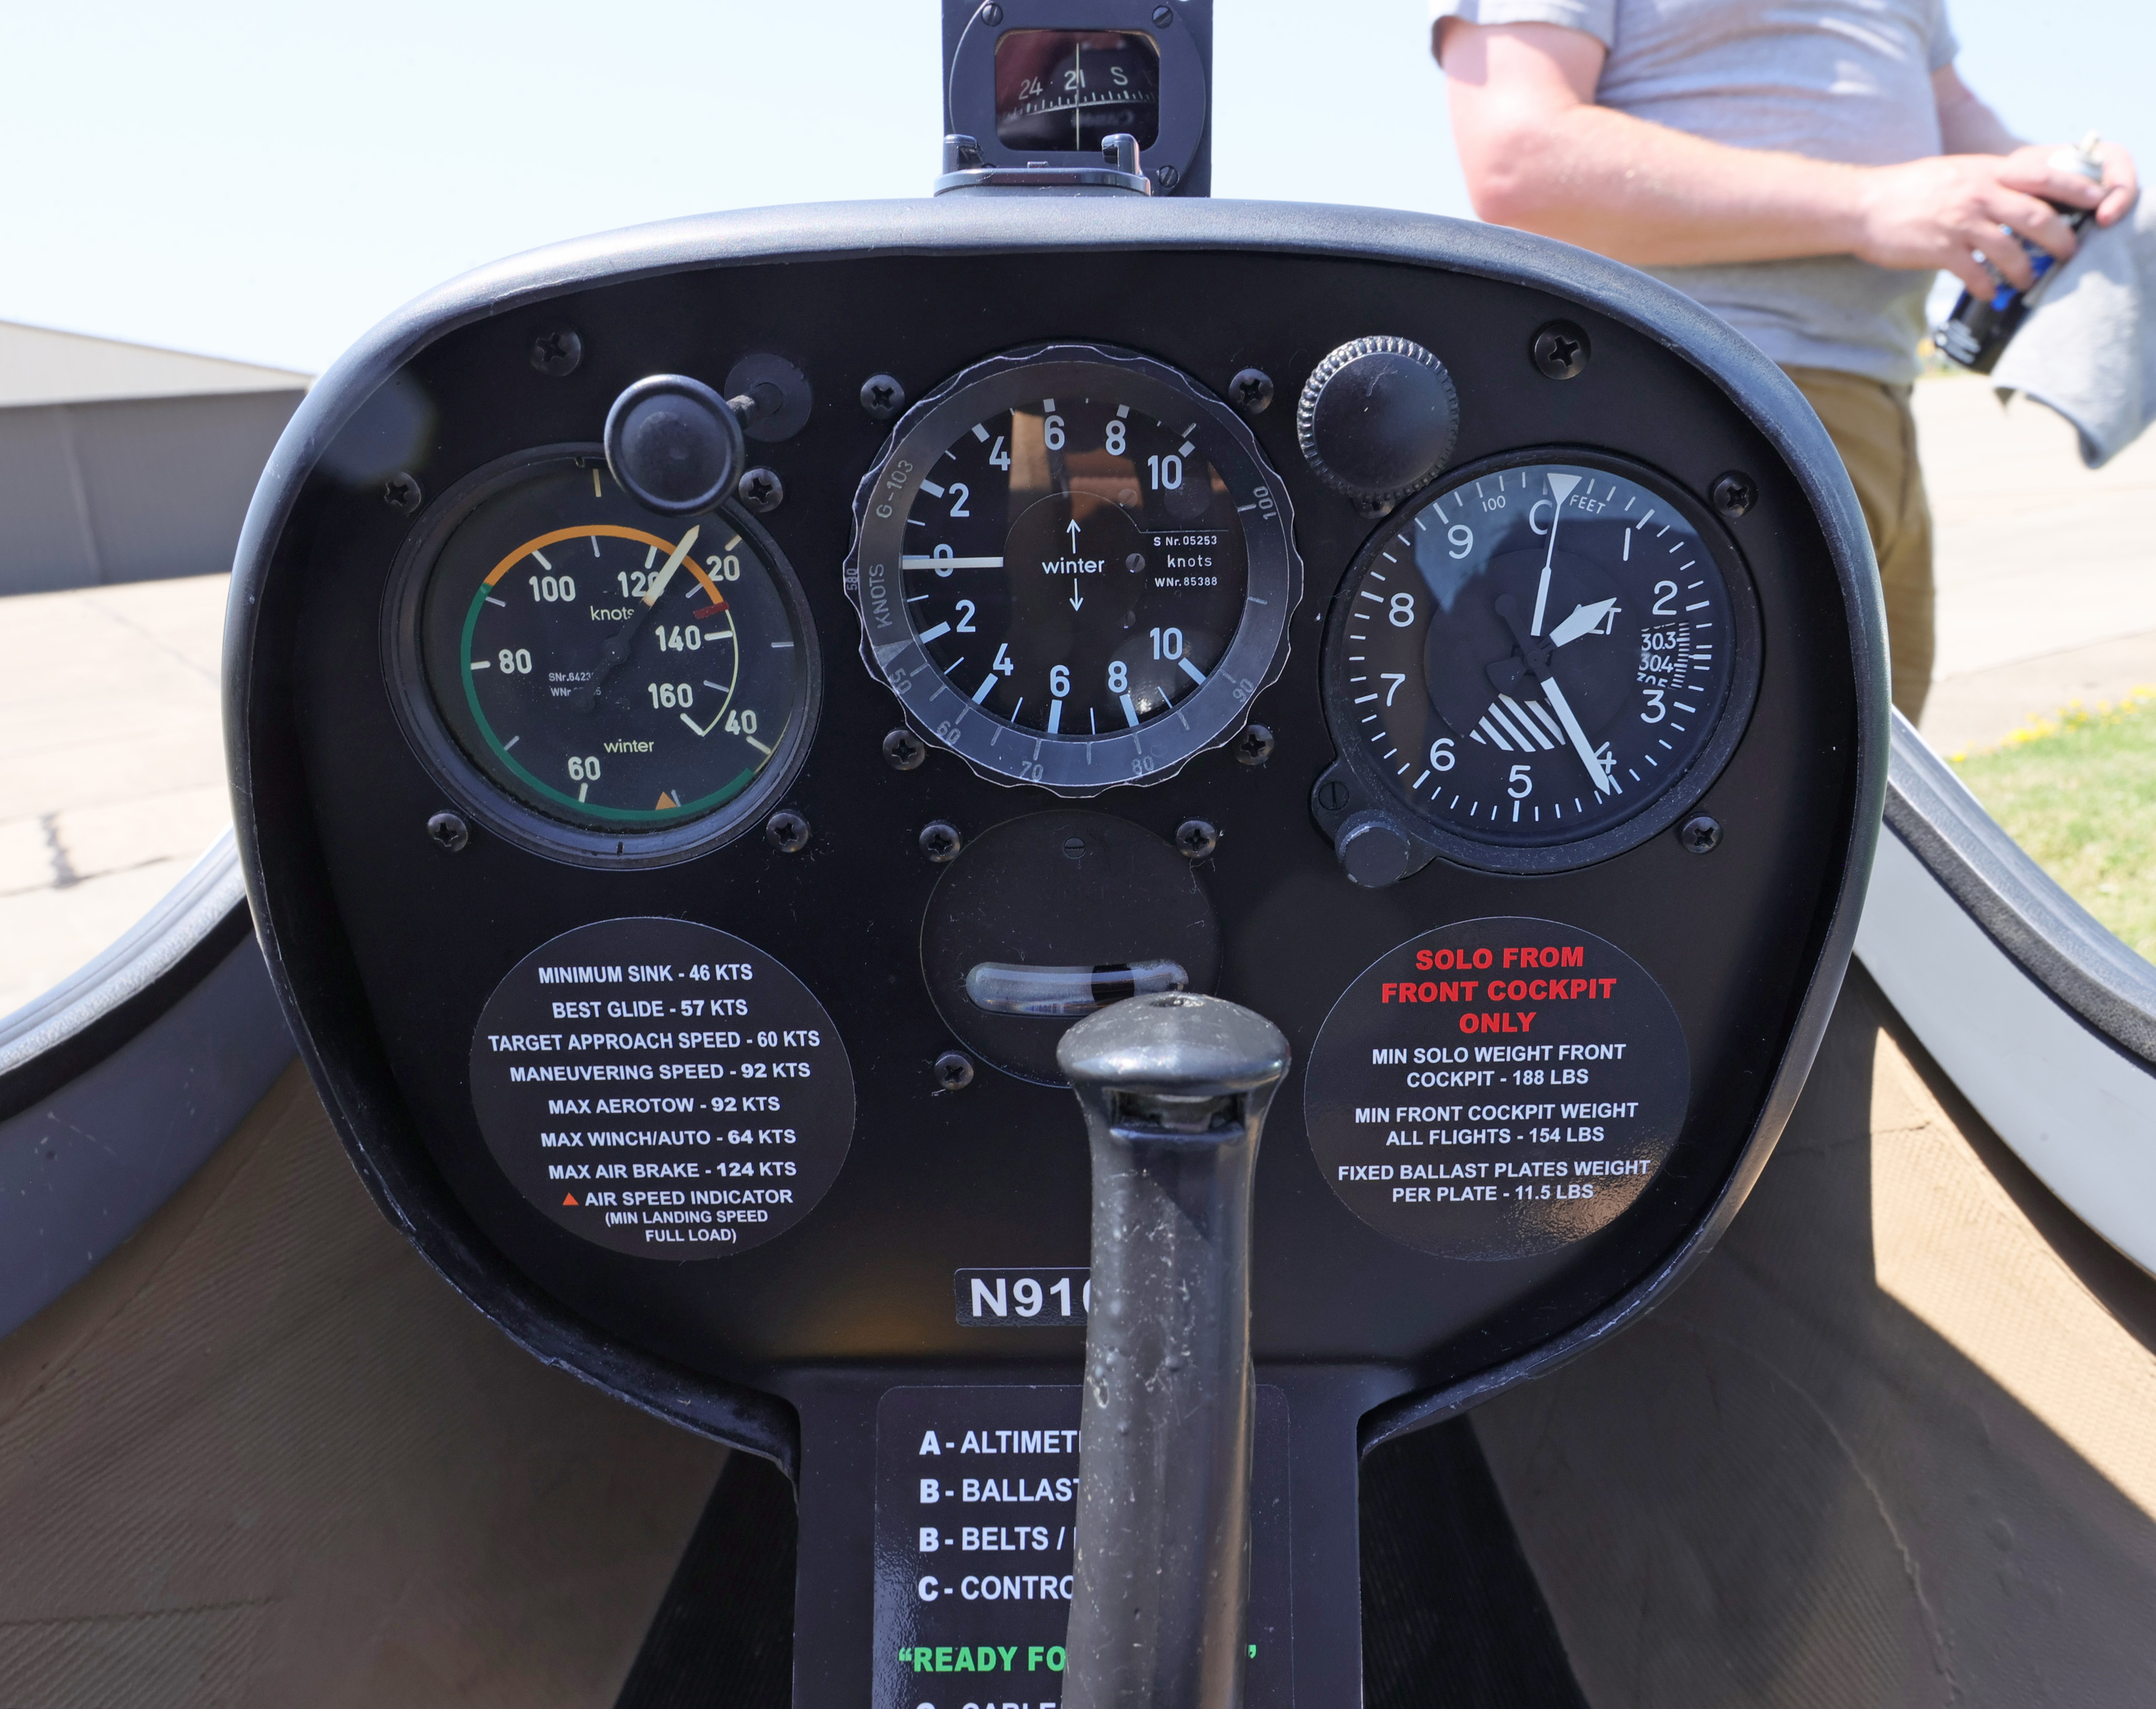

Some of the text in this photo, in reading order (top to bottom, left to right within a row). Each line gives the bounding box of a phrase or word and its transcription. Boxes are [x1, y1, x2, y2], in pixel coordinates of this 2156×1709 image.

[1019, 66, 1128, 100] 24 21 S
[1044, 415, 1065, 451] 6
[1106, 421, 1125, 455] 8
[989, 436, 1010, 471] 4
[1148, 455, 1182, 489] 10
[876, 460, 913, 518] G-103
[949, 483, 969, 517] 2
[1483, 496, 1505, 512] 100
[1570, 495, 1605, 514] FEET
[1154, 537, 1161, 546] S
[1448, 525, 1473, 559] 9
[1623, 528, 1630, 561] 1
[706, 556, 740, 581] 20
[1042, 557, 1104, 574] winter
[1167, 555, 1211, 568] knots
[529, 576, 576, 601] 100
[869, 564, 892, 628] KNOTS
[1652, 581, 1677, 615] 2
[956, 600, 976, 632] 2
[1389, 593, 1414, 627] 8
[655, 625, 701, 651] 140
[1150, 628, 1182, 660] 10
[1642, 632, 1676, 651] 30.3
[499, 649, 532, 674] 80
[993, 644, 1013, 675] 4
[1051, 665, 1070, 697] 6
[1108, 661, 1127, 693] 8
[648, 684, 693, 708] 160
[1380, 674, 1405, 707] 7
[1641, 690, 1665, 723] 3
[725, 710, 757, 735] 40
[604, 739, 654, 752] winter
[1430, 738, 1455, 771] 6
[1594, 741, 1617, 774] 4
[568, 756, 600, 780] 60
[1508, 765, 1532, 798] 5
[1416, 947, 1583, 970] SOLO FROM
[539, 966, 622, 983] MINIMUM
[628, 965, 673, 982] SINK
[690, 965, 710, 981] 46
[715, 964, 753, 980] KTS
[1382, 979, 1616, 1003] FRONT COCKPIT
[552, 1002, 601, 1018] BEST
[608, 1001, 664, 1017] GLIDE
[681, 1000, 705, 1016] 57
[711, 999, 748, 1015] KTS
[1460, 1012, 1536, 1033] ONLY
[488, 1034, 562, 1051] TARGET
[568, 1033, 673, 1050] APPROACH
[679, 1032, 740, 1048] SPEED
[757, 1031, 778, 1047] 60
[784, 1030, 820, 1046] KTS
[1373, 1044, 1626, 1064] MIN SOLO WEIGHT FRONT
[510, 1065, 653, 1081] MANEUVERING
[660, 1064, 724, 1079] SPEED
[741, 1064, 767, 1078] 92
[773, 1063, 810, 1077] KTS
[1407, 1071, 1494, 1087] COCKPIT
[1513, 1070, 1544, 1085] 188
[1551, 1069, 1588, 1084] LBS
[549, 1099, 591, 1114] MAX
[596, 1098, 694, 1113] AEROTOW
[711, 1097, 737, 1111] 92
[743, 1097, 780, 1111] KTS
[1356, 1103, 1638, 1123] MIN FRONT COCKPIT WEIGHT
[541, 1132, 583, 1147] MAX
[588, 1130, 710, 1146] WINCH/AUTO
[728, 1130, 753, 1144] 64
[759, 1129, 796, 1143] KTS
[1386, 1131, 1423, 1145] ALL
[1430, 1129, 1511, 1144] FLIGHTS
[1530, 1128, 1560, 1142] 154
[1567, 1127, 1604, 1141] LBS
[549, 1165, 591, 1179] MAX
[596, 1164, 628, 1178] AIR
[633, 1163, 699, 1178] BRAKE
[717, 1162, 754, 1176] 124
[759, 1162, 797, 1176] KTS
[1339, 1160, 1651, 1180] FIXED BALLAST PLATES WEIGHT
[586, 1190, 793, 1206] AIR SPEED INDICATOR
[1393, 1188, 1430, 1202] PER
[1438, 1186, 1497, 1201] PLATE
[1516, 1185, 1550, 1200] 11.5
[1557, 1184, 1593, 1199] LBS
[606, 1210, 768, 1227] (MIN LANDING SPEED
[645, 1229, 736, 1243] FULL LOAD)
[971, 1277, 1090, 1317] N91
[919, 1431, 940, 1455] A
[960, 1430, 1081, 1454] ALTIMET
[920, 1479, 939, 1503] B
[920, 1528, 939, 1551] B
[962, 1527, 1048, 1550] BELTS
[918, 1576, 938, 1601] C
